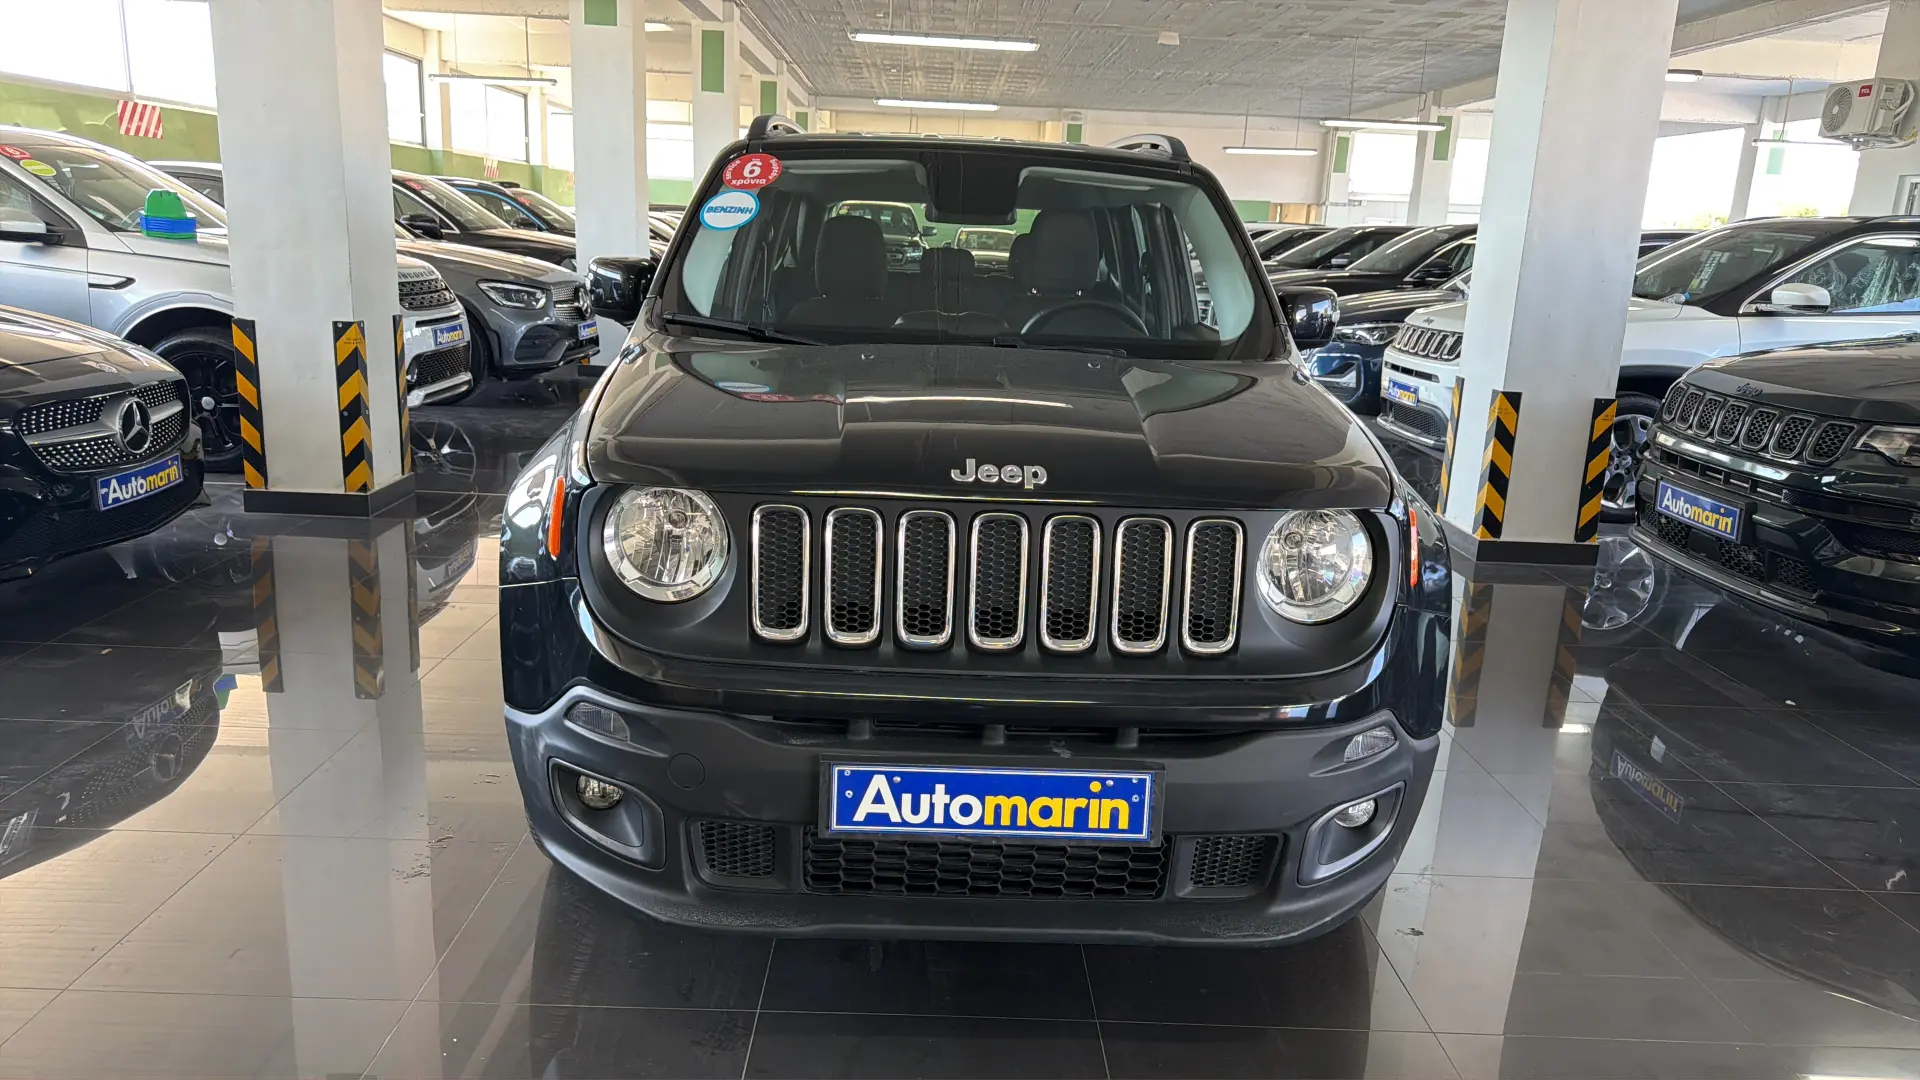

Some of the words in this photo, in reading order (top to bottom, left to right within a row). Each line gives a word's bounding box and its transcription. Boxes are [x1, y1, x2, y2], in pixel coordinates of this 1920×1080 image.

[731, 178, 766, 186] χρόνια
[743, 161, 762, 178] 6
[108, 460, 178, 504] Automarin
[950, 459, 1047, 489] Jeep
[1662, 488, 1732, 533] Automarin
[853, 774, 1129, 830] Automarin
